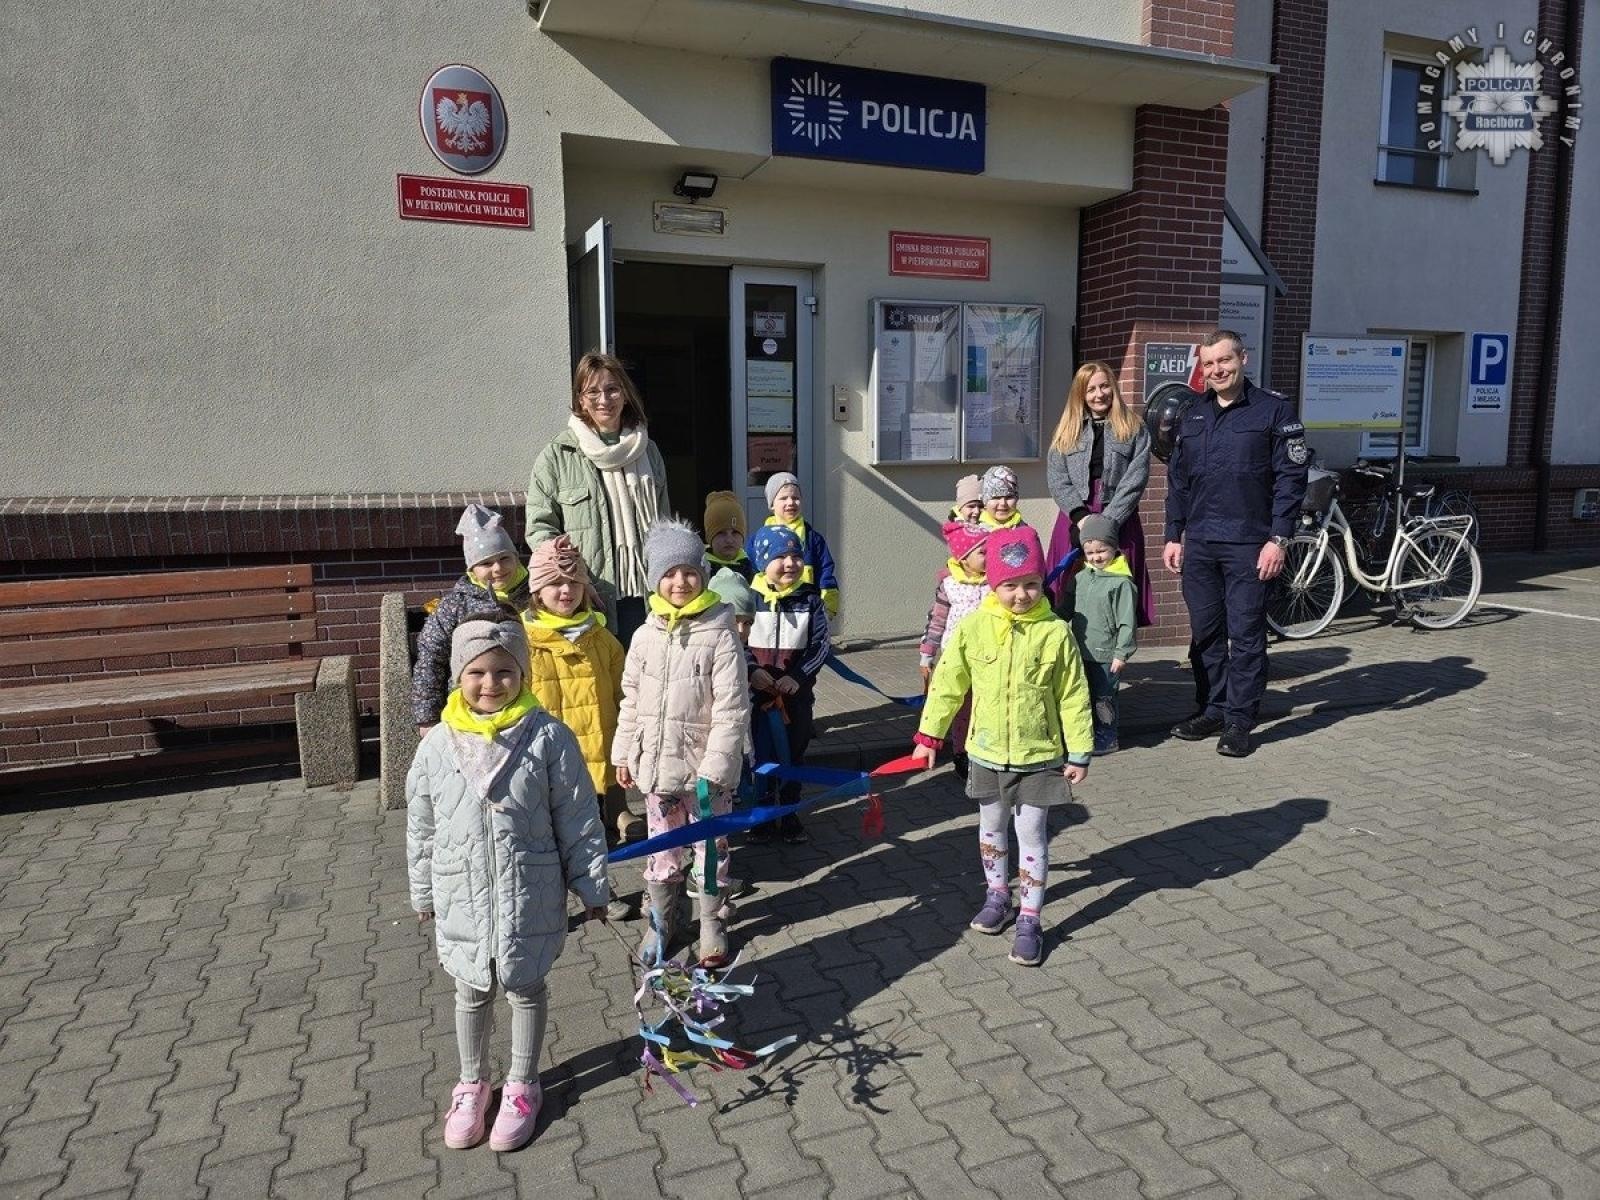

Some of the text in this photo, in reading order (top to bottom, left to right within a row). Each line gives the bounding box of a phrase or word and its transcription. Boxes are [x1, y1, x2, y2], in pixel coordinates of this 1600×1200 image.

[861, 100, 977, 141] POLICJA
[420, 186, 510, 204] POSTERUNEK POLICJI
[405, 198, 525, 218] W PIETROWICACH WIELKICH
[919, 245, 954, 256] BIBLIOTEKA
[954, 247, 985, 257] PUBLICZNA
[907, 313, 940, 324] POLICJA
[1159, 359, 1186, 373] AED
[1478, 338, 1504, 381] P
